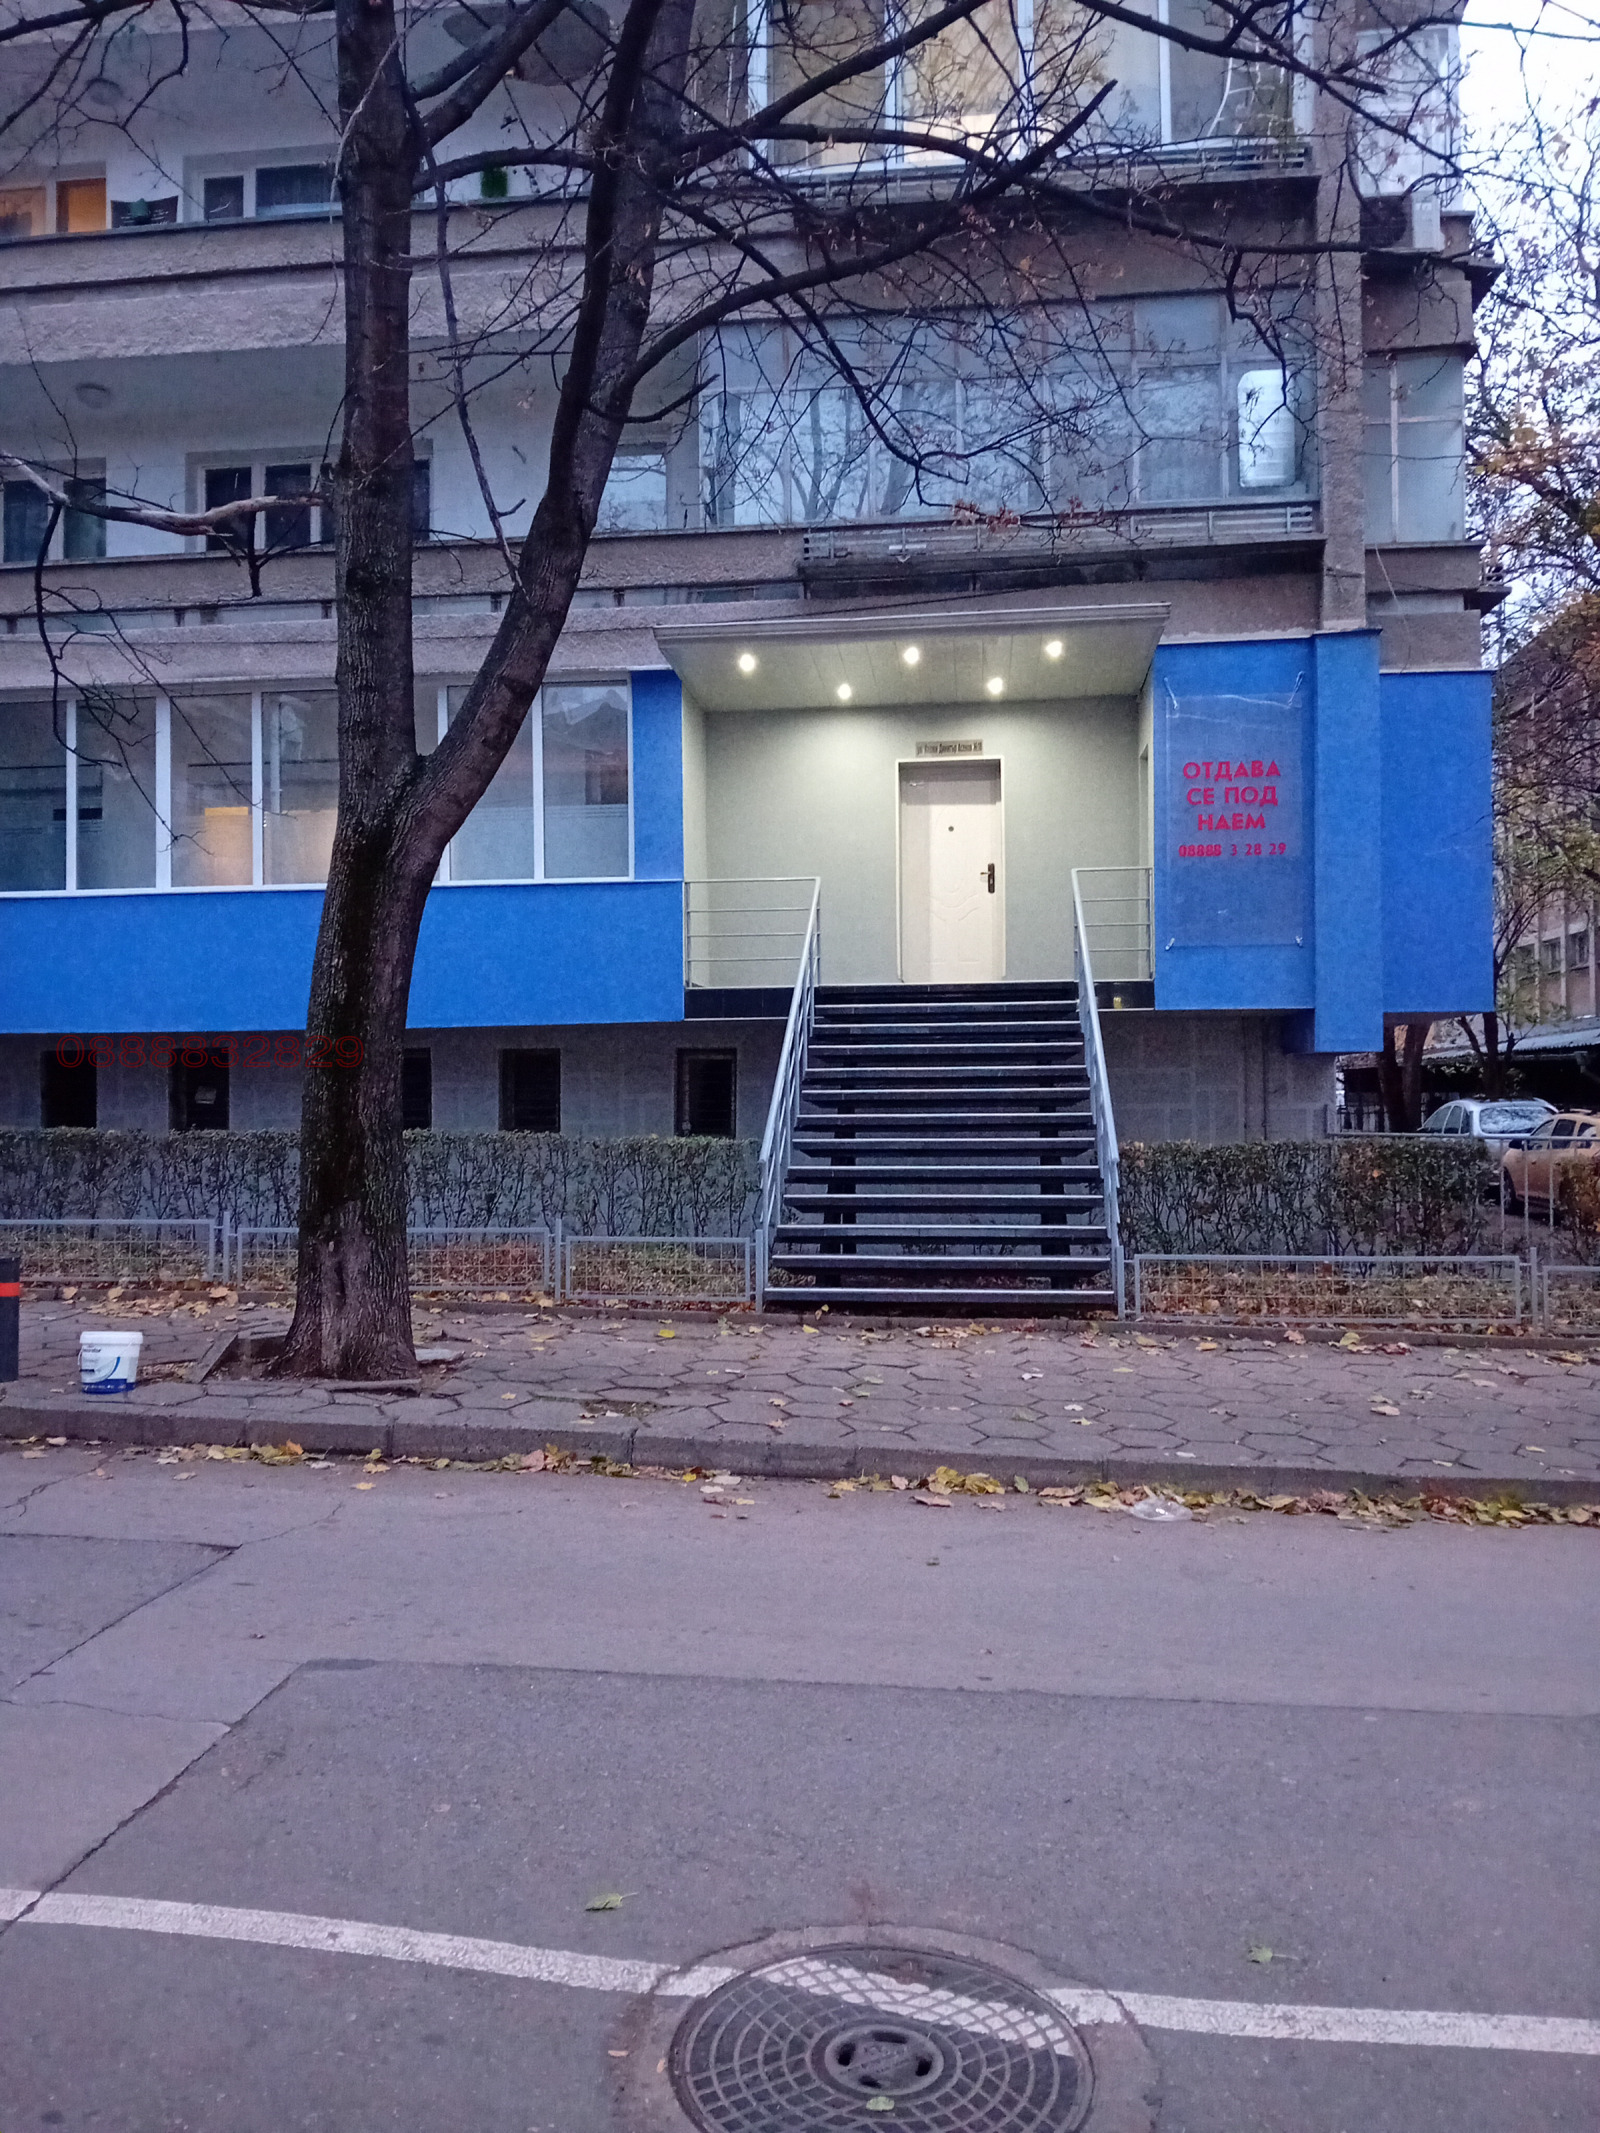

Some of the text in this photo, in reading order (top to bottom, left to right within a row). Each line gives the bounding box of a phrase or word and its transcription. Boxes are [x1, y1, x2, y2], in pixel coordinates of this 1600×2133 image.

[1182, 760, 1281, 782] ОТДАВА
[1186, 785, 1279, 807] СЕ ПОД
[1197, 812, 1266, 831] НАЕМ
[1178, 842, 1287, 857] 08888 3 28 29
